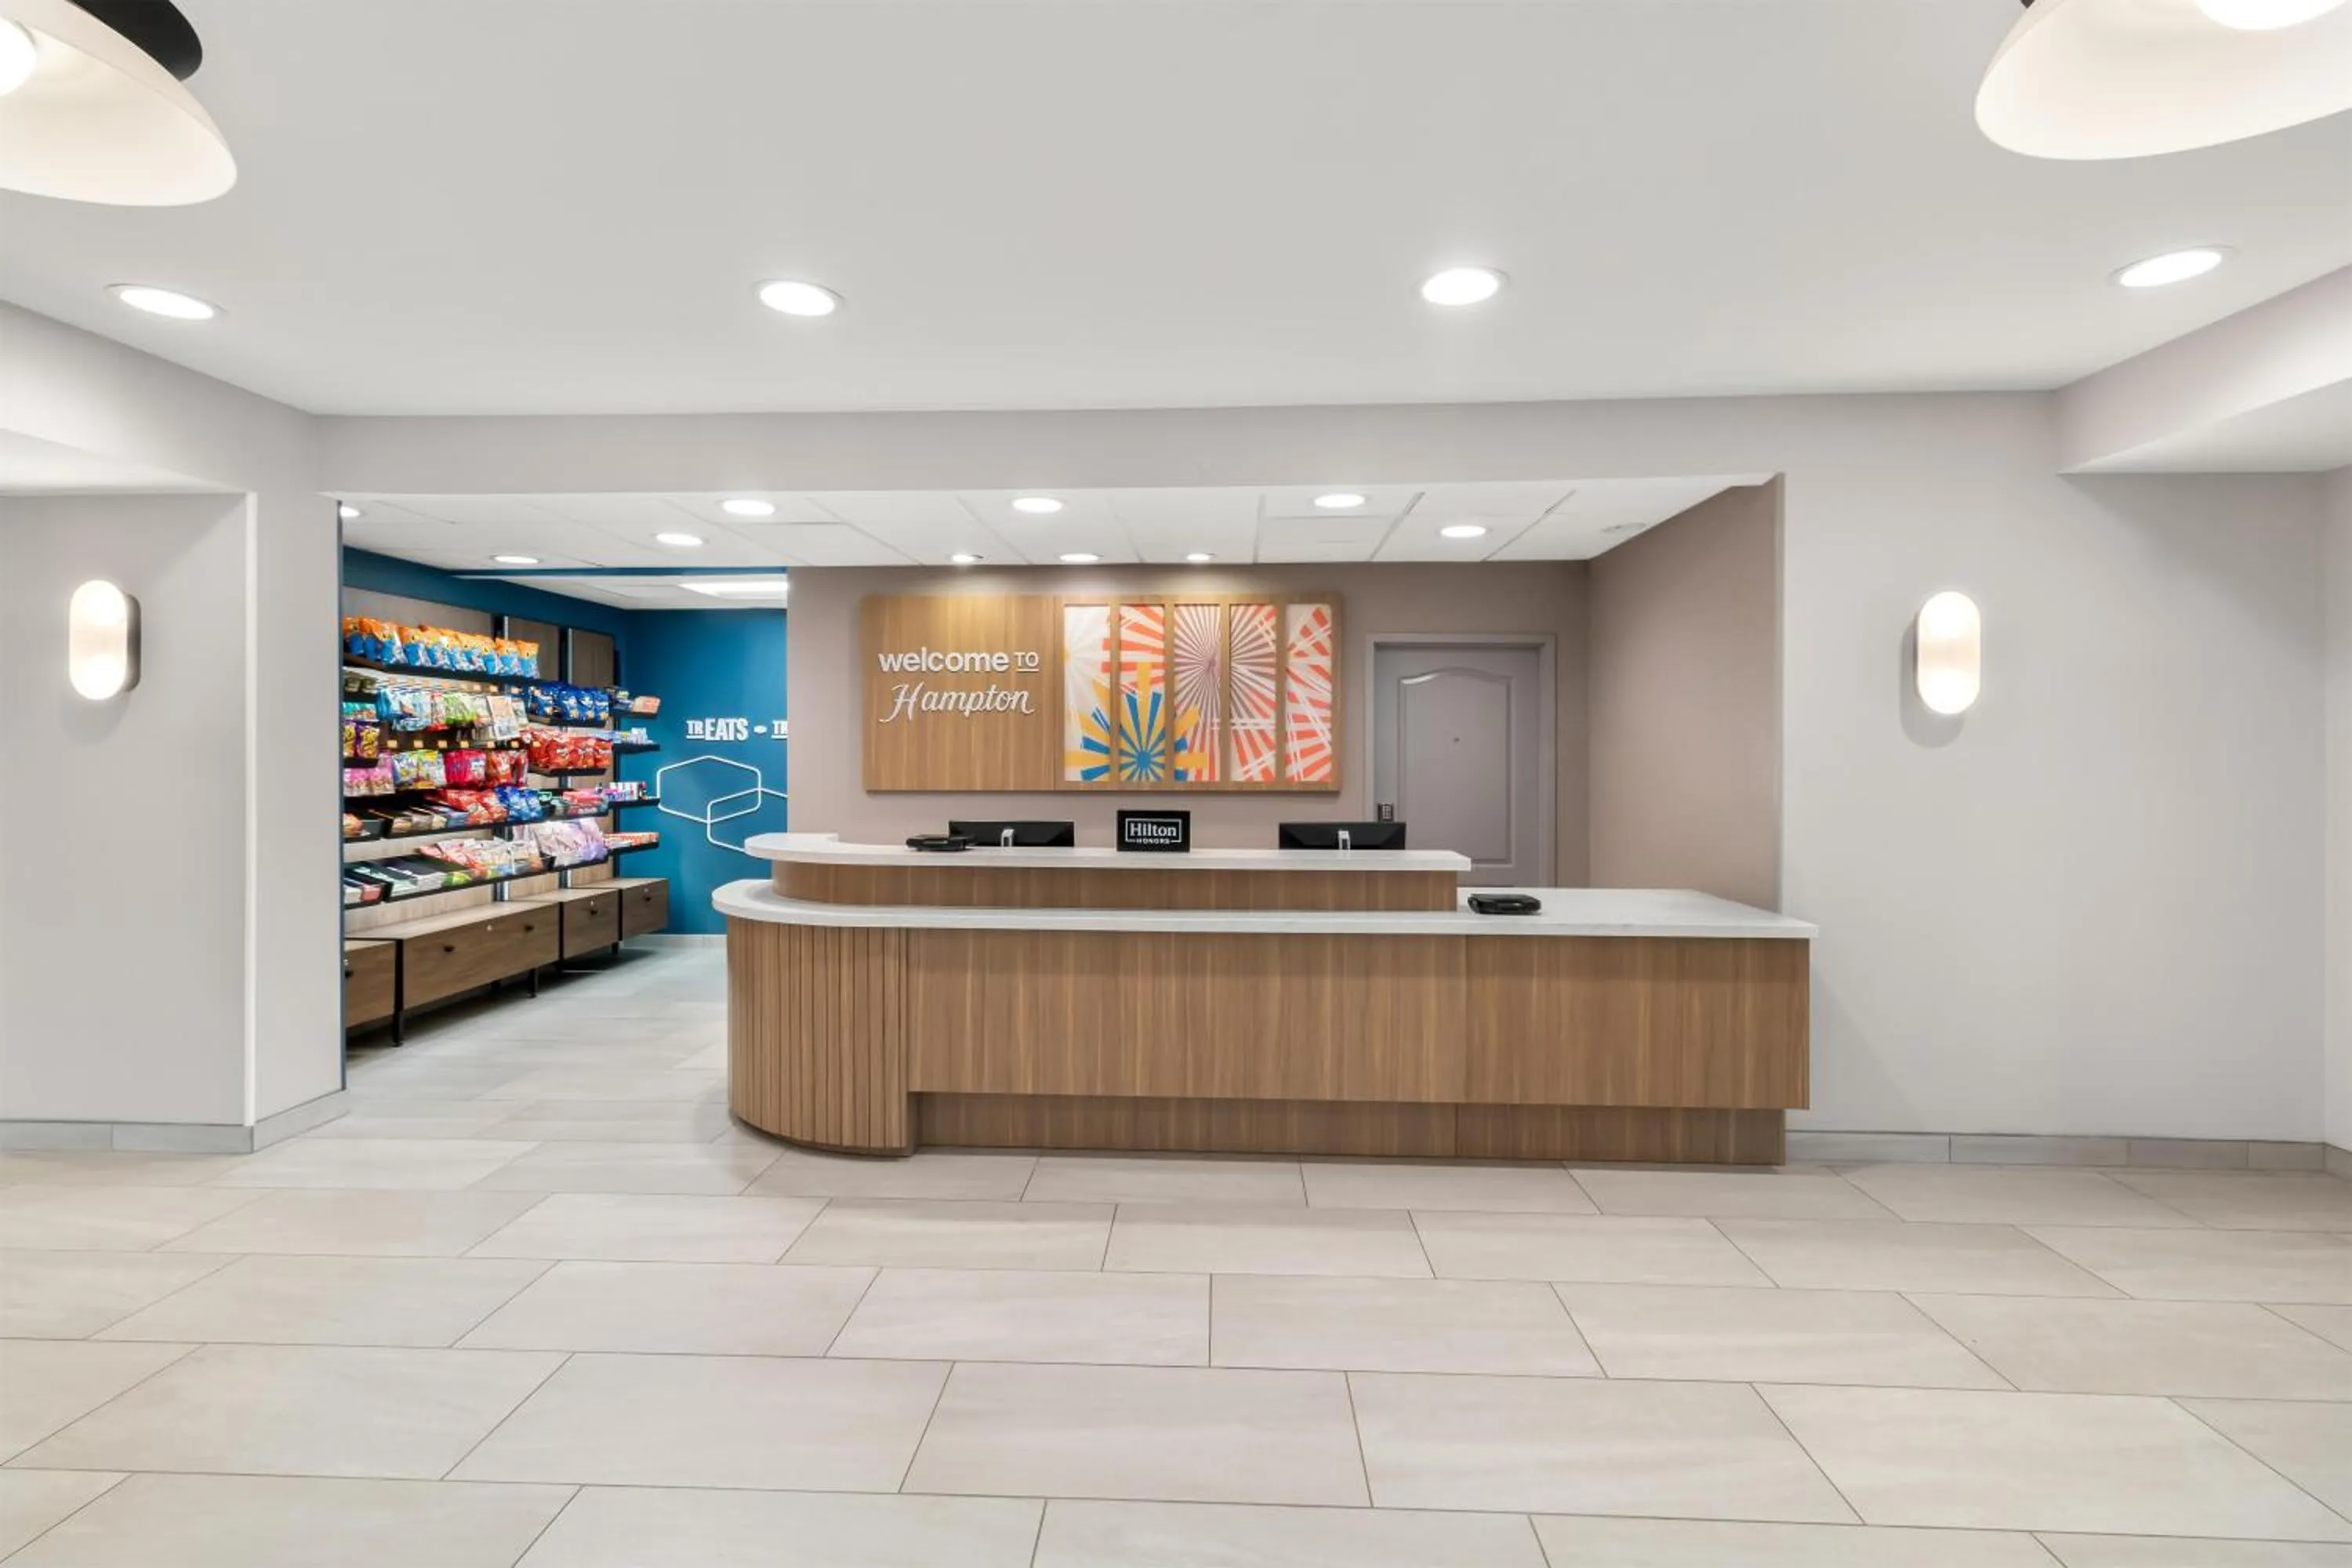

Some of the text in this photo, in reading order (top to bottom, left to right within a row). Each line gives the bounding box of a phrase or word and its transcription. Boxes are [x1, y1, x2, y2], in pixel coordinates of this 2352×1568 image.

[878, 647, 1040, 672] welcome TO
[878, 681, 1035, 723] Hampton
[686, 718, 749, 741] TREATS
[1130, 822, 1177, 837] Hilton
